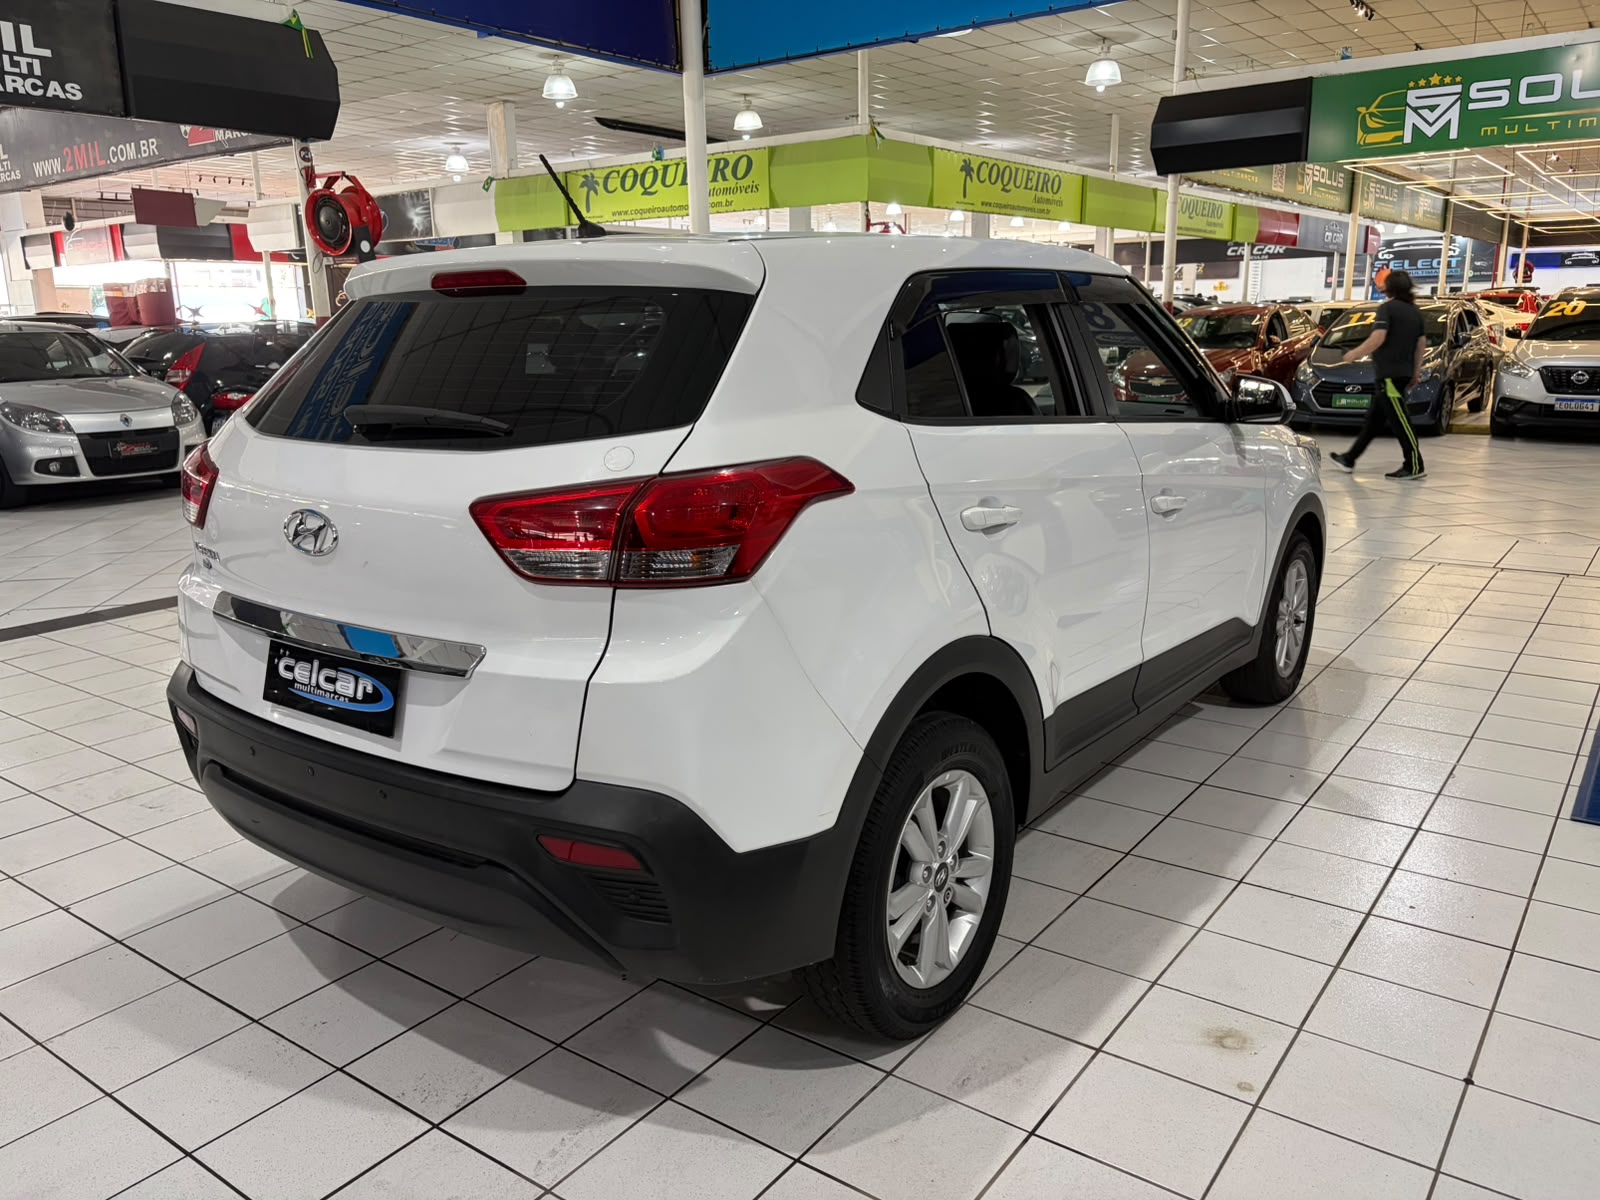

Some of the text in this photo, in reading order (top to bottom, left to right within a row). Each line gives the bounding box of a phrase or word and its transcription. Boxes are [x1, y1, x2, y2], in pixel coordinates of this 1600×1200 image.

[0, 74, 83, 101] RCAS
[33, 137, 160, 178] WWW.2MIL.COM.BR
[602, 153, 754, 196] COQURO
[976, 160, 1062, 195] COQUEIRO
[1178, 196, 1224, 220] OQUEIRO
[1545, 300, 1587, 318] 20
[277, 656, 374, 701] celcar
[293, 681, 350, 703] multimarcas
